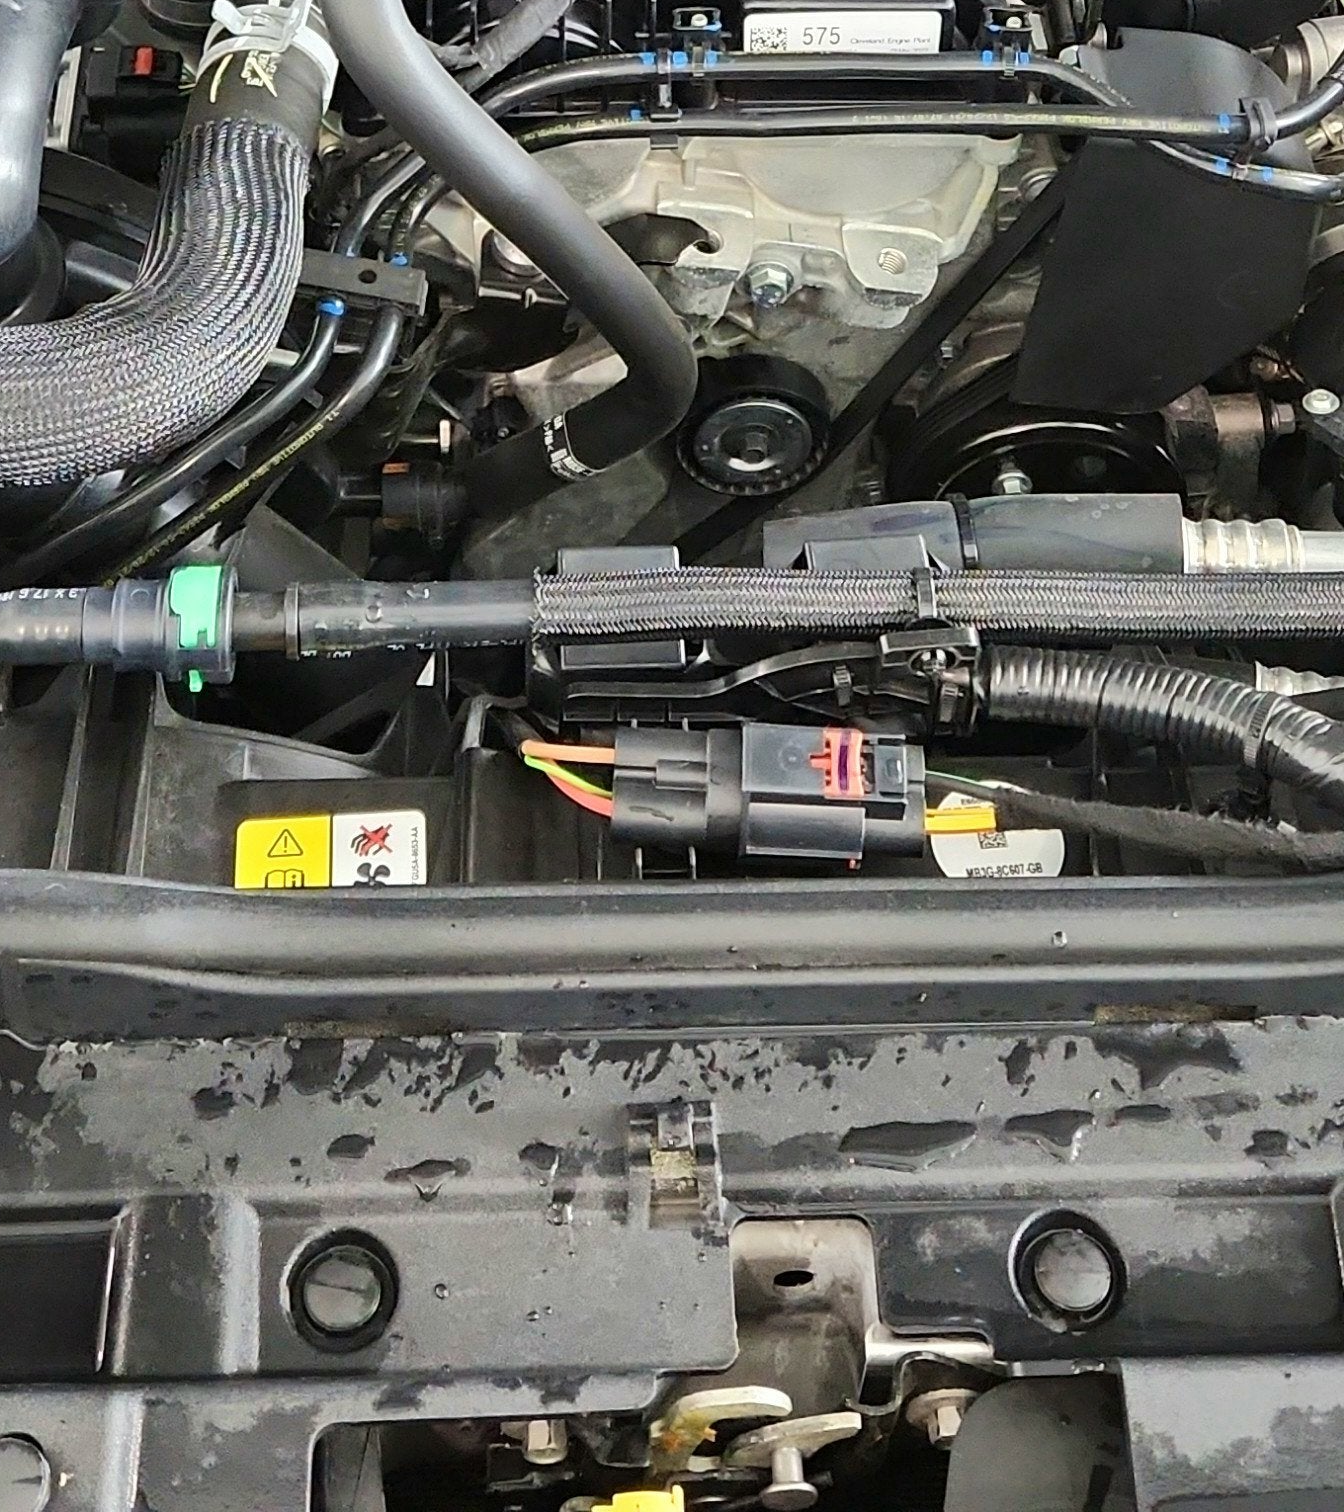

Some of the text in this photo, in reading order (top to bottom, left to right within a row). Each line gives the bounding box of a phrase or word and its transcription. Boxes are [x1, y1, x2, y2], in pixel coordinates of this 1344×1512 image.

[802, 26, 840, 45] 575
[887, 37, 911, 46] Engine
[913, 36, 931, 44] Plant
